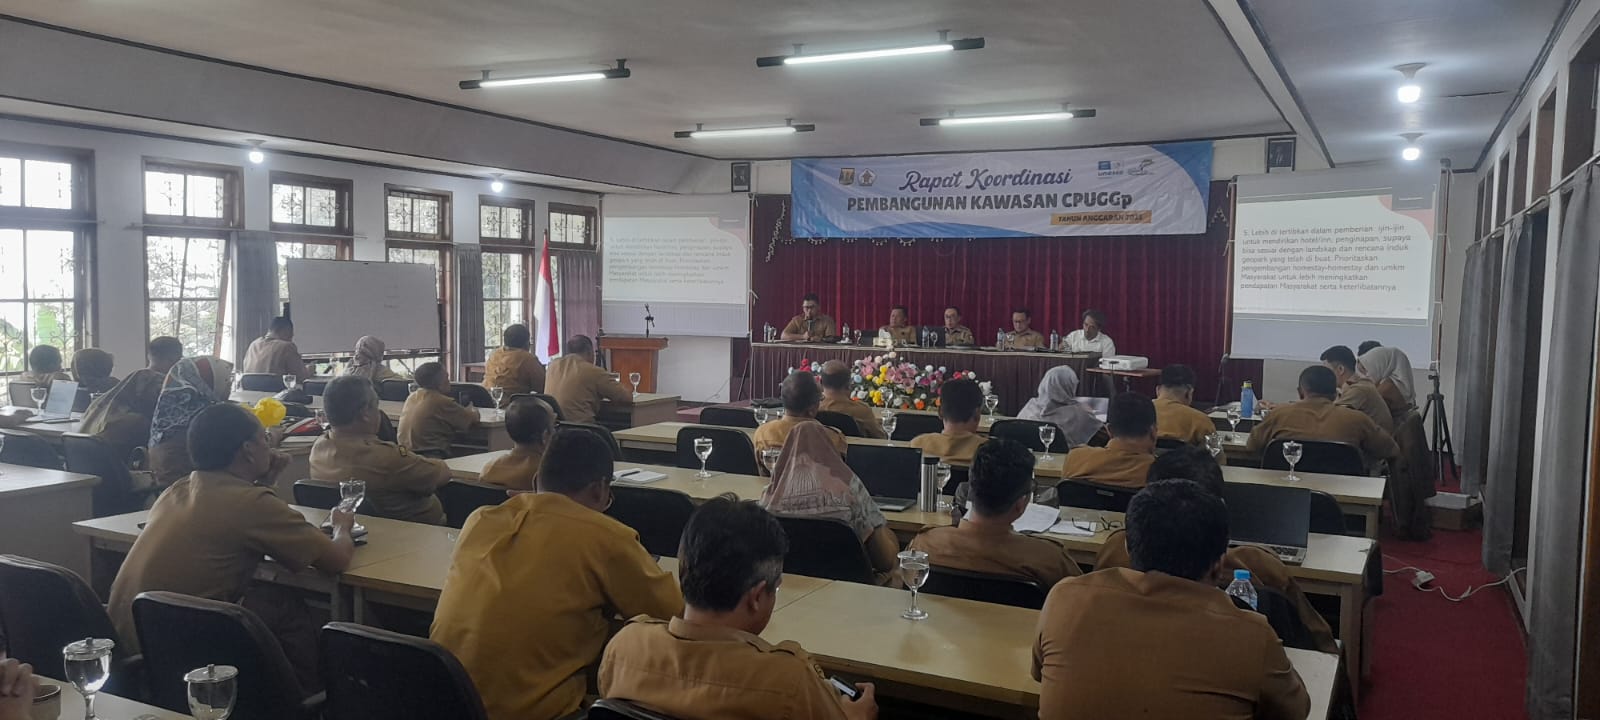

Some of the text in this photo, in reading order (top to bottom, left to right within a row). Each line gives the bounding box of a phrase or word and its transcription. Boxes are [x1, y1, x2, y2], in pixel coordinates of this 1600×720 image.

[899, 168, 1073, 192] Rapat Koordinasi
[847, 191, 1133, 212] PEMBANGUNAN KAWASAN CPUGGp
[1082, 214, 1124, 222] ANGGARAN
[1383, 234, 1411, 243] supaya
[1278, 246, 1304, 254] dengan
[1240, 273, 1276, 281] Masyarakat
[1280, 282, 1317, 292] Masyarakat
